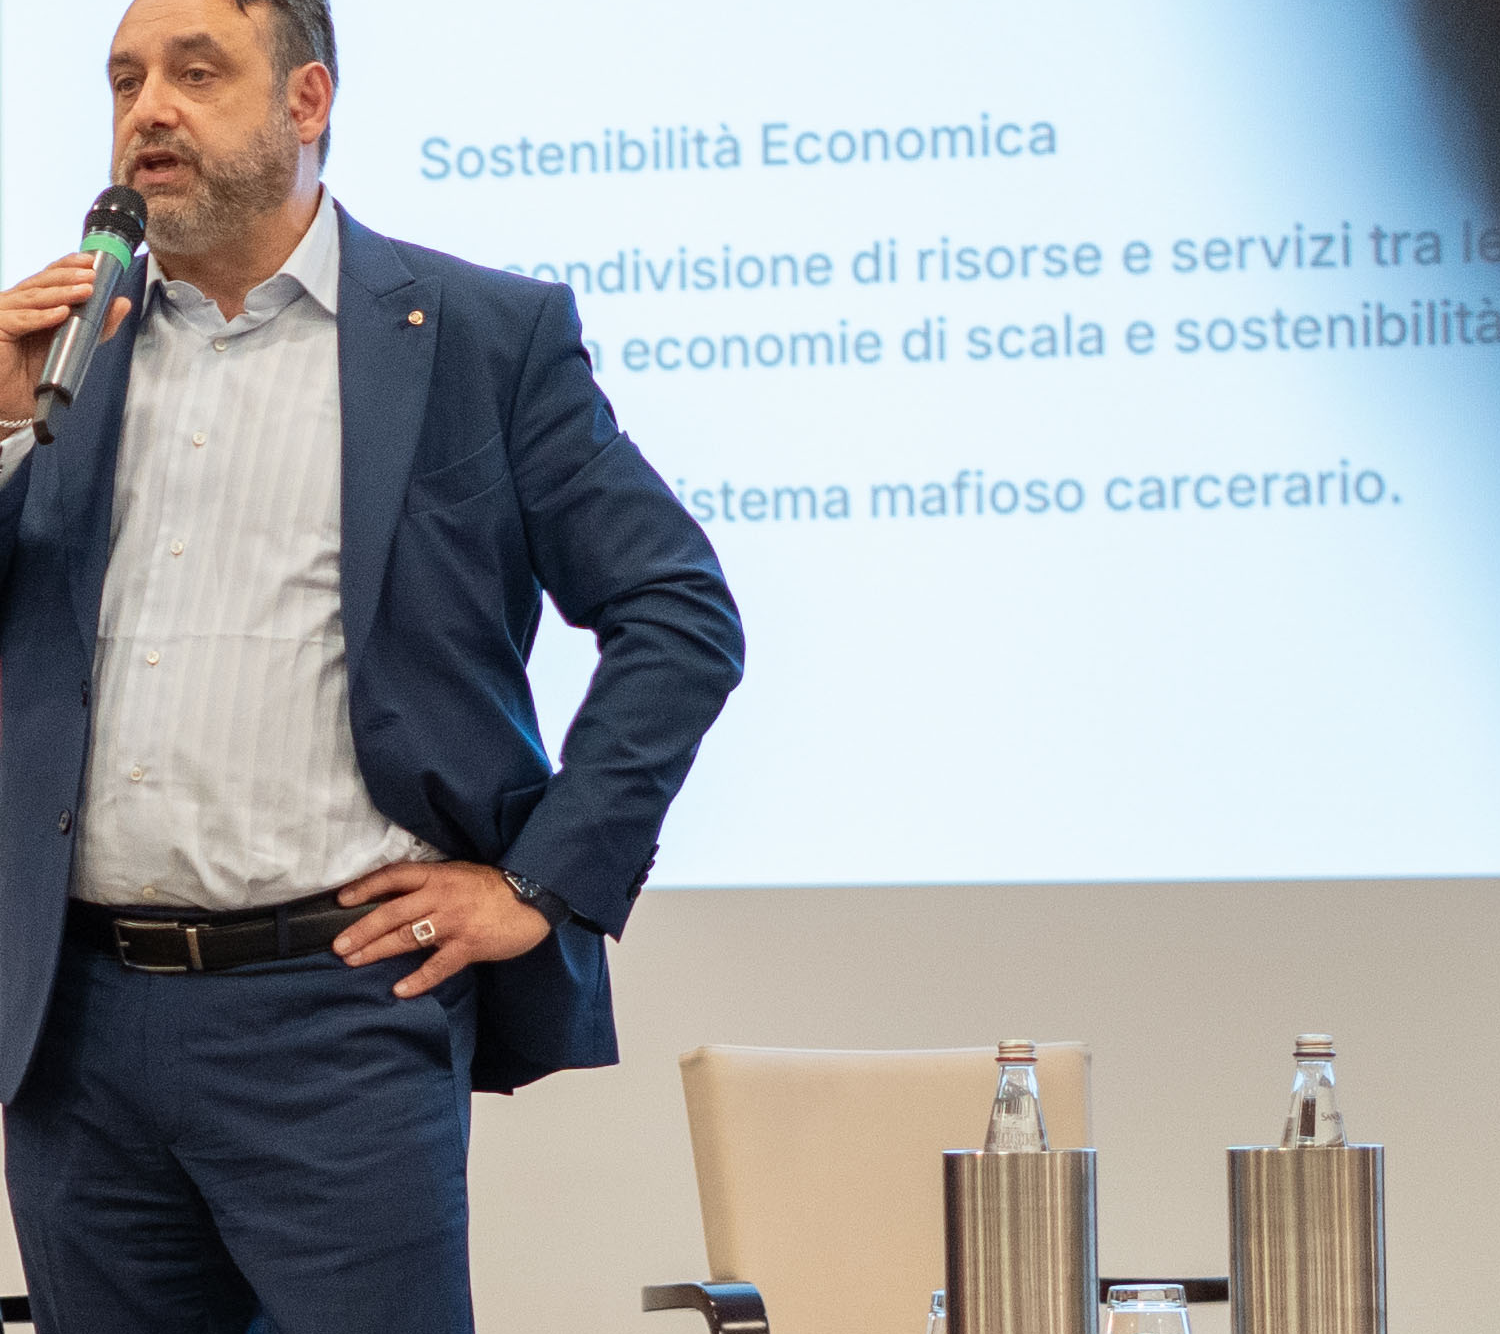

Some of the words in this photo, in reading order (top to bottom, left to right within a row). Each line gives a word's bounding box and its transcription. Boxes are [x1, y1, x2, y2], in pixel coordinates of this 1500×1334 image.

[421, 123, 742, 181] Sostenibilità
[762, 112, 1057, 166] Economica
[851, 238, 897, 285] di
[918, 236, 1103, 282] risorse
[1122, 240, 1153, 275] e
[1172, 221, 1352, 274] servizi
[1369, 225, 1442, 267] tra
[621, 319, 883, 373] economie
[902, 316, 946, 363] di
[967, 313, 1105, 361] scala
[1125, 320, 1156, 356] e
[677, 478, 851, 523] istema
[871, 469, 1086, 519] mafioso
[1104, 459, 1402, 512] carcerario.
